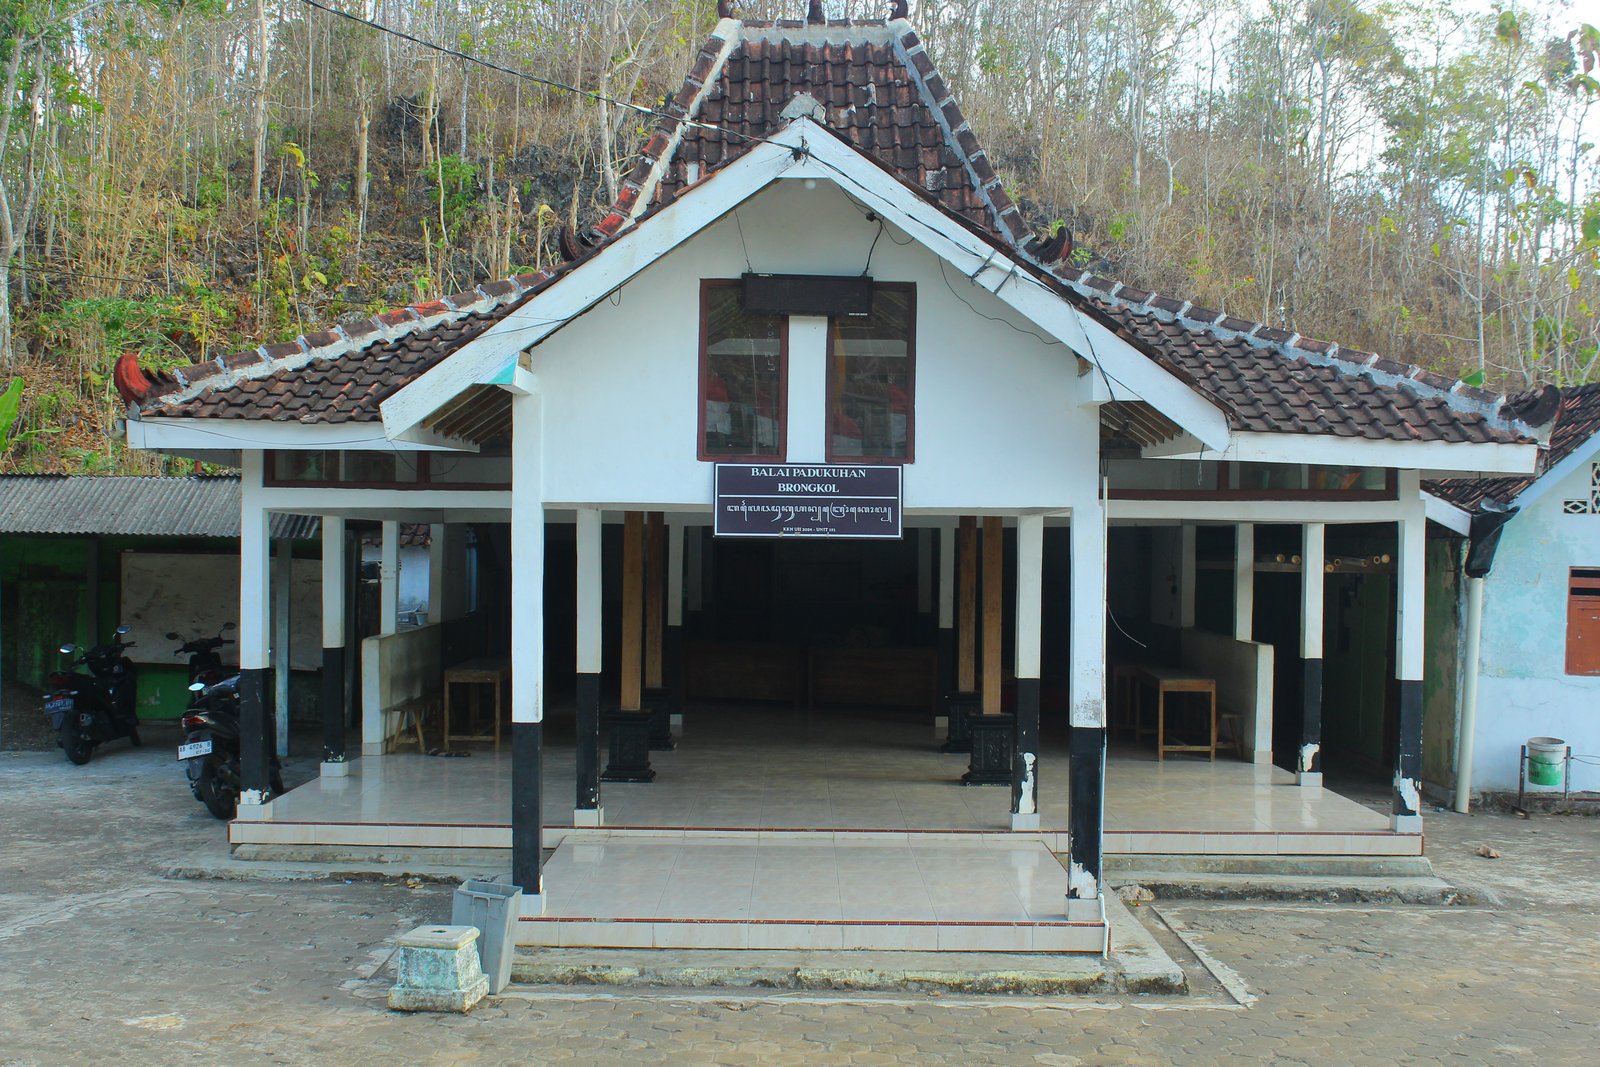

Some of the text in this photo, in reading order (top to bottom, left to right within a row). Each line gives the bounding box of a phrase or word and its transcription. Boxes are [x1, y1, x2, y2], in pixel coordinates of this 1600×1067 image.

[751, 467, 866, 478] BALAI PADUKUHAN
[777, 483, 839, 493] BRONGKOL
